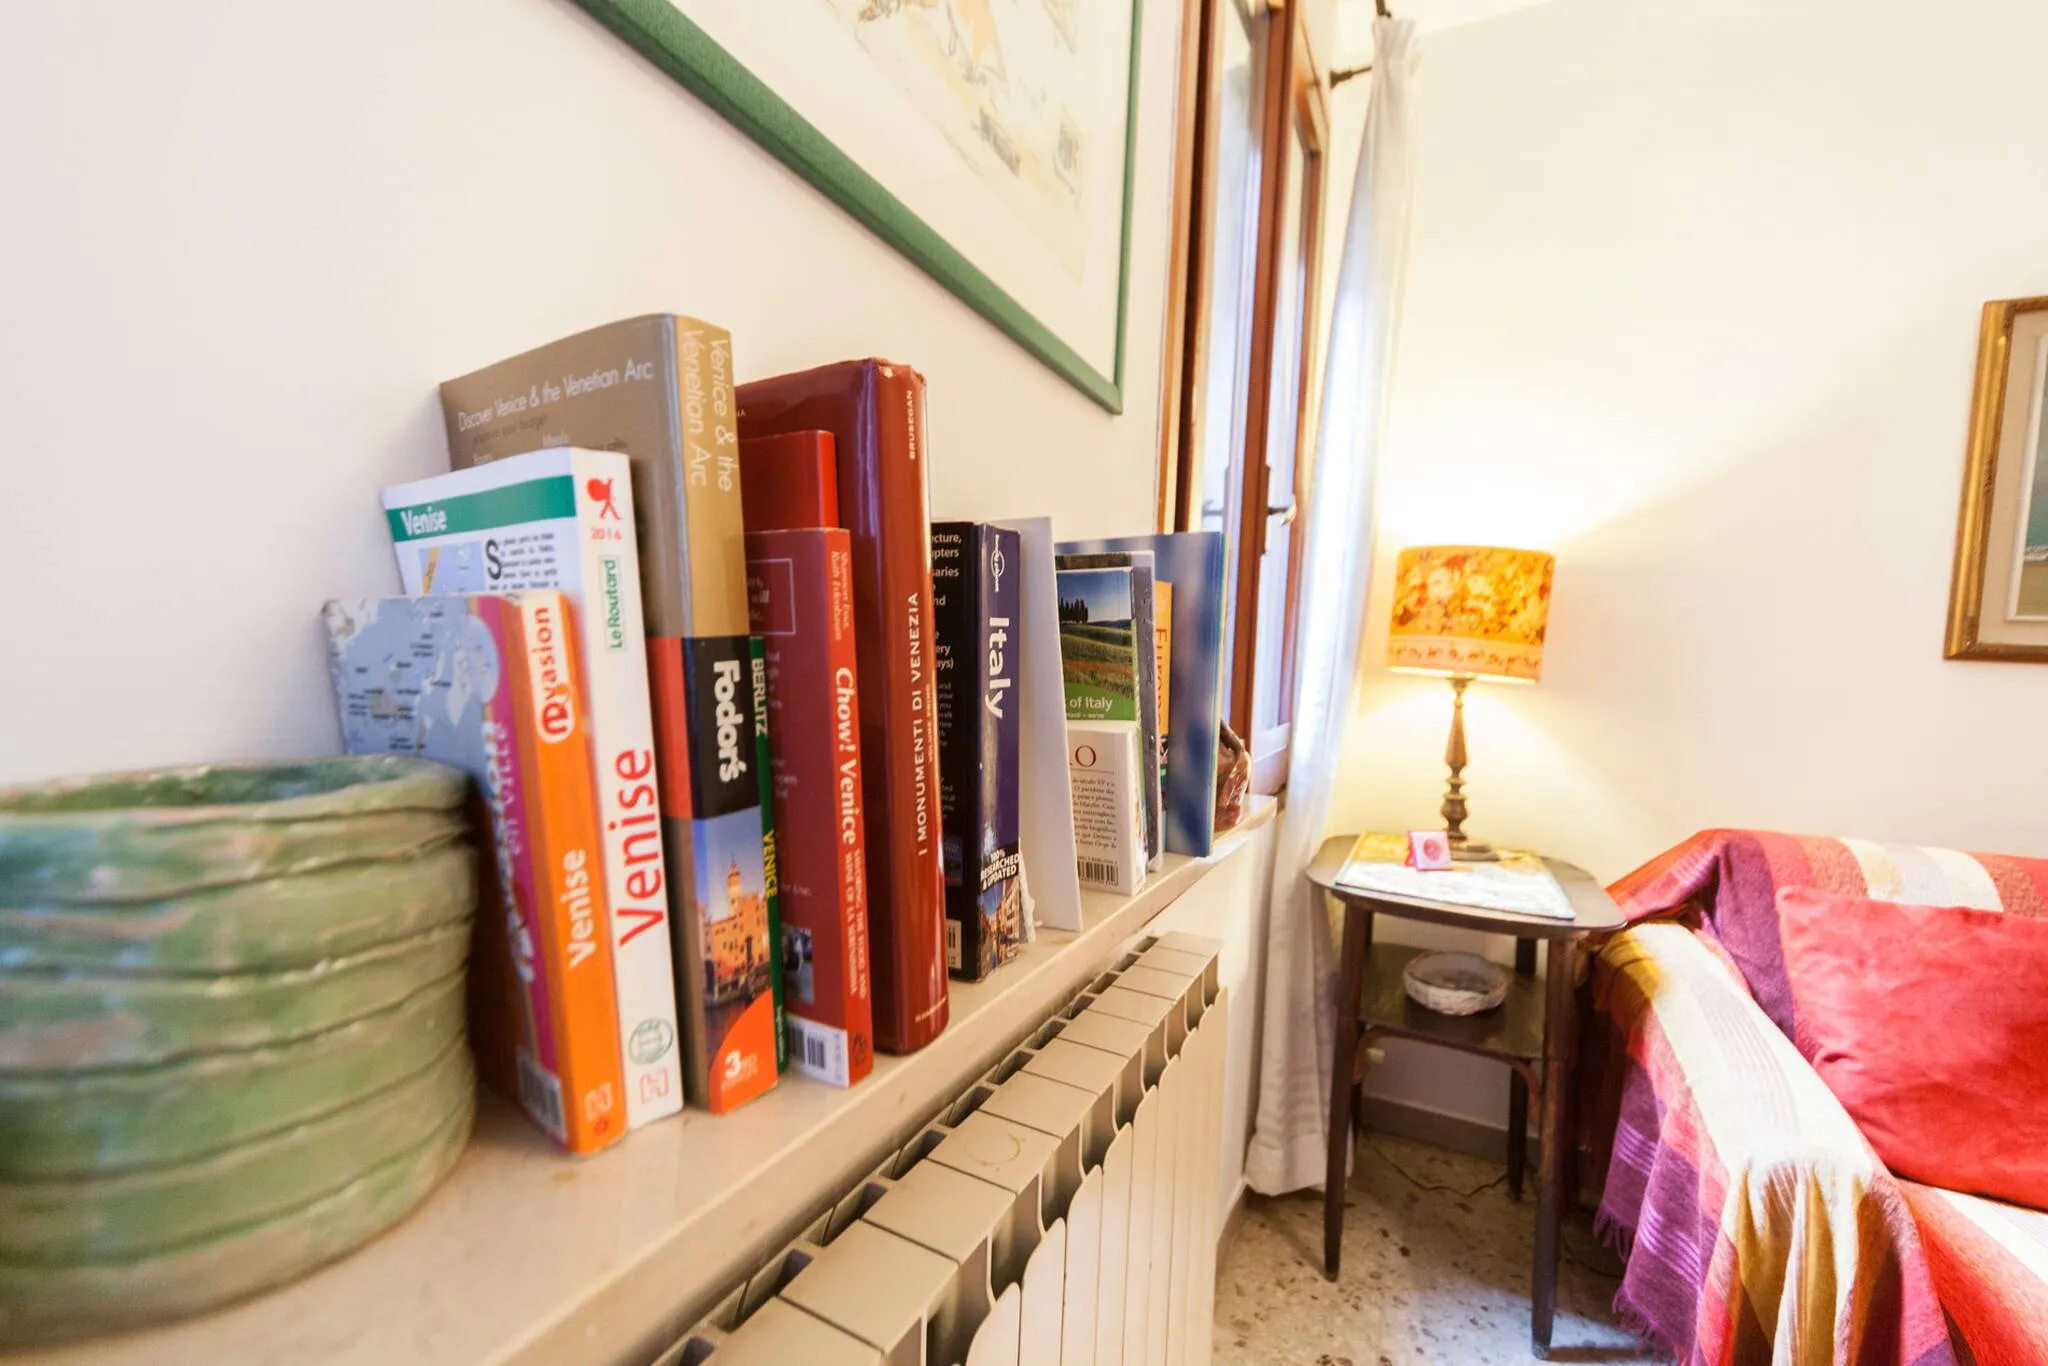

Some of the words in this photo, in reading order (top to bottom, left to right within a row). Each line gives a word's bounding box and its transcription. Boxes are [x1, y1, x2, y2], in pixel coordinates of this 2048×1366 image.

[458, 405, 493, 432] Discover
[493, 394, 527, 418] Venice
[530, 384, 540, 408] &
[542, 380, 561, 403] the
[562, 367, 620, 397] Venetian
[623, 357, 654, 383] Arc
[682, 329, 707, 435] Venetian
[710, 338, 729, 418] Venice
[715, 425, 736, 446] &
[906, 390, 916, 460] BRUSEGAN
[690, 444, 713, 488] Arc
[715, 455, 739, 493] the
[400, 505, 447, 536] Venise
[590, 527, 623, 541] 2016
[908, 592, 921, 683] VENEZIA
[985, 616, 1011, 719] Italy
[713, 659, 747, 783] Fodor's
[751, 657, 768, 738] BERLITZ
[835, 666, 857, 753] Chow!
[911, 688, 923, 711] DI
[1069, 696, 1082, 708] of
[1085, 696, 1113, 713] Italy
[913, 719, 928, 842] MONUMENTI
[1074, 744, 1097, 768] O
[840, 758, 861, 845] Venice
[608, 748, 665, 947] Venise
[762, 829, 778, 898] VENICE
[980, 853, 1020, 883] RESEARCHED
[987, 864, 1017, 887] UPDATED
[560, 848, 598, 970] Venise
